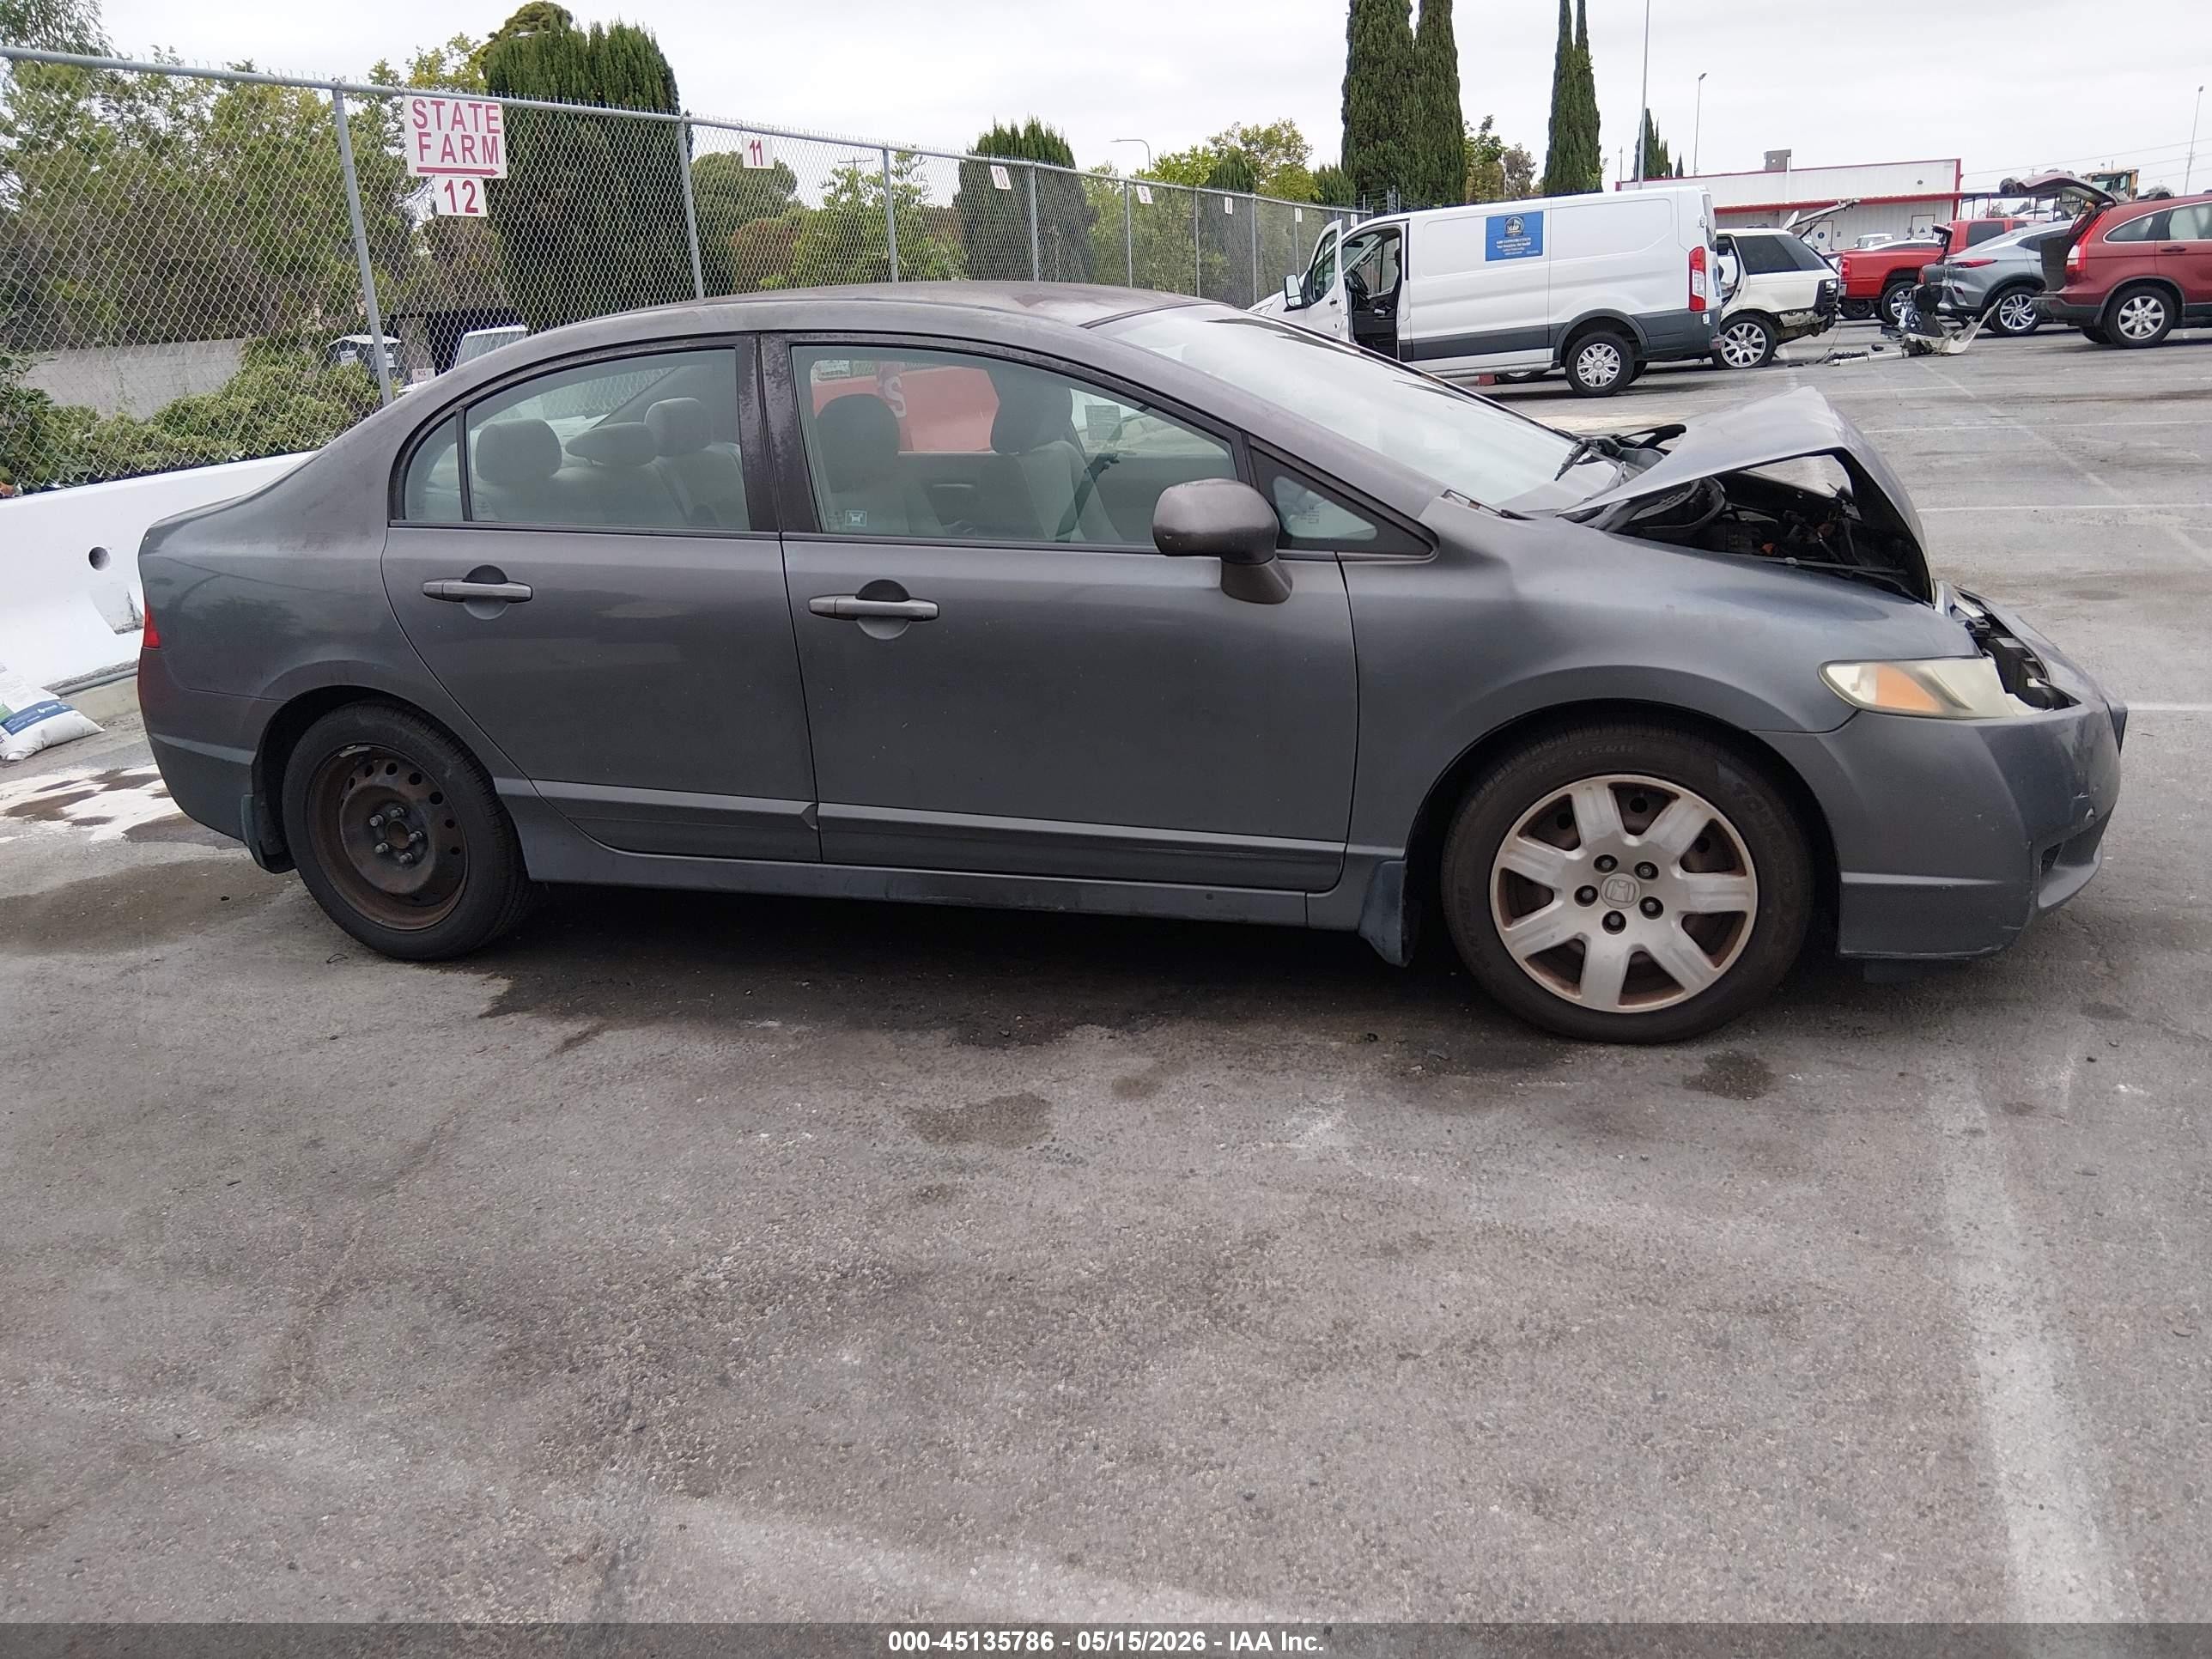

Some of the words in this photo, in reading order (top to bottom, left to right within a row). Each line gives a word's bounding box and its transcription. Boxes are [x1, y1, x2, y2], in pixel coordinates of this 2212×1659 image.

[412, 99, 501, 134] STATE
[418, 131, 499, 164] FARM
[749, 139, 763, 166] 11
[994, 167, 1007, 187] 10
[444, 179, 478, 213] 12
